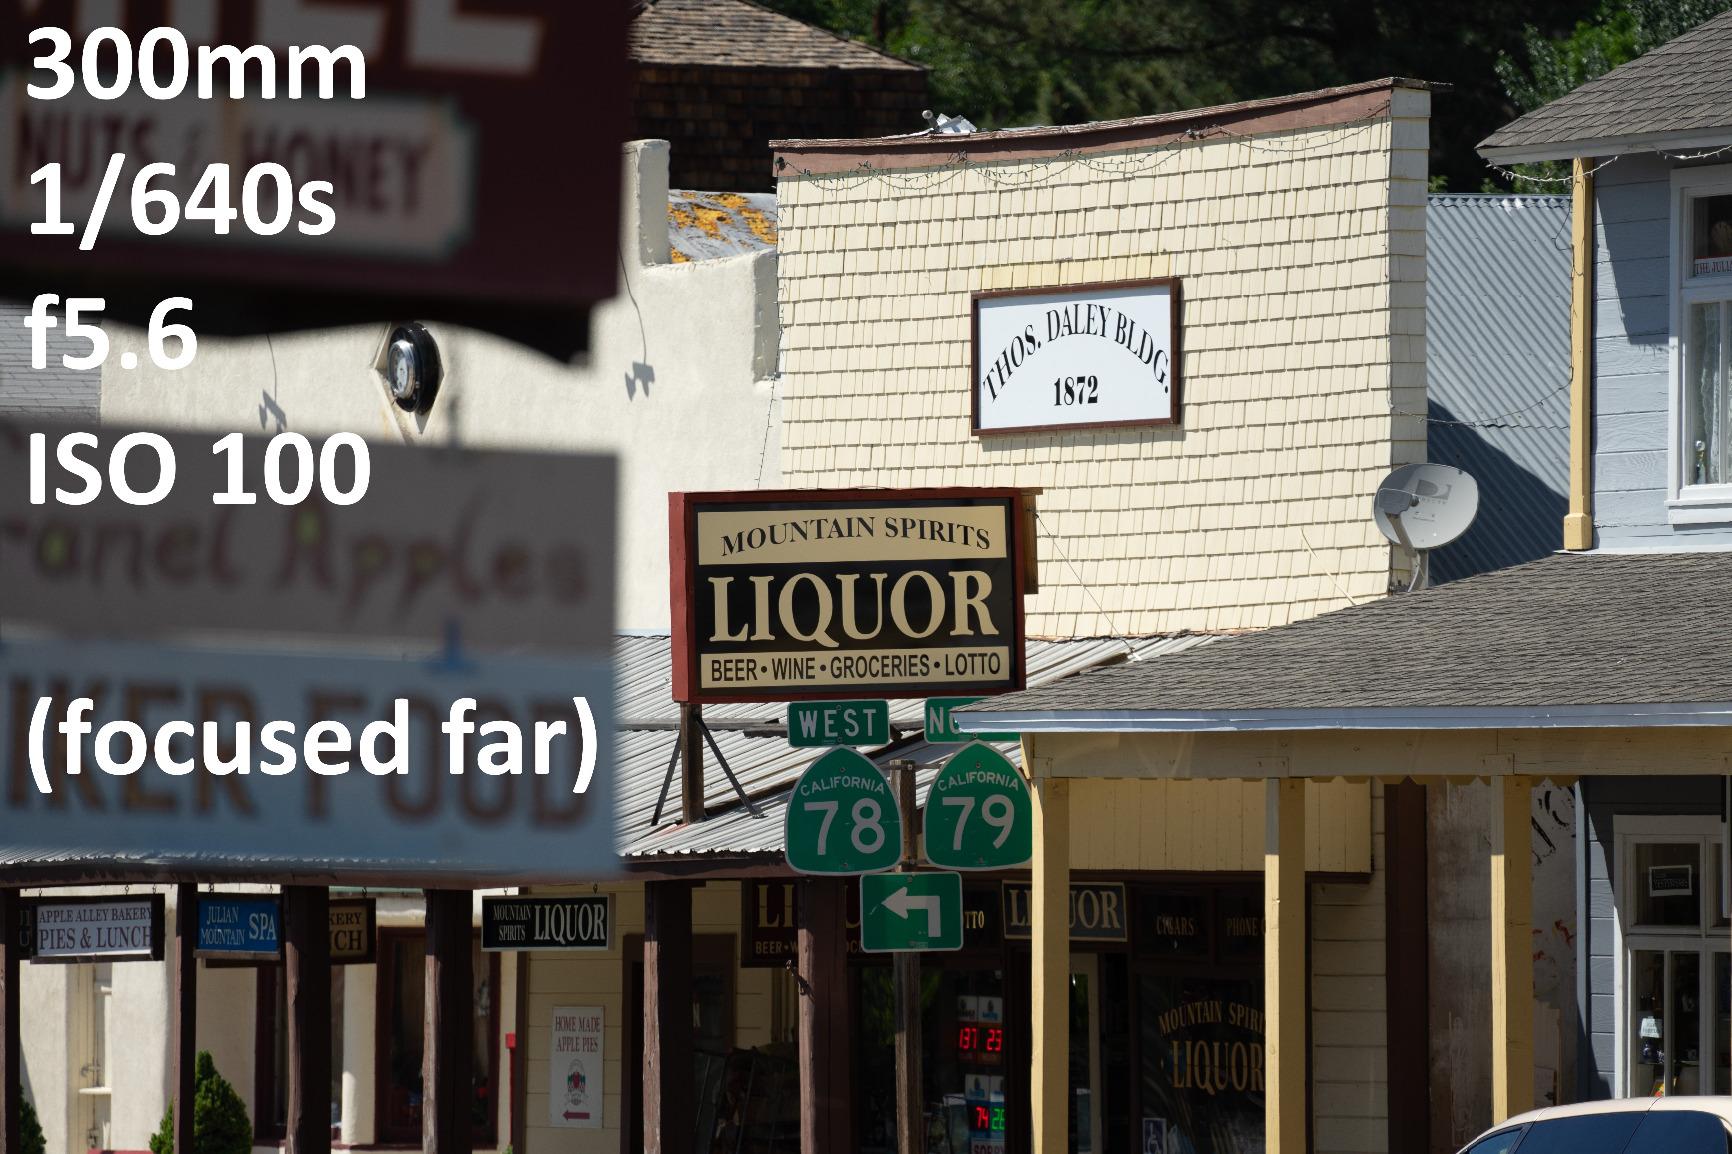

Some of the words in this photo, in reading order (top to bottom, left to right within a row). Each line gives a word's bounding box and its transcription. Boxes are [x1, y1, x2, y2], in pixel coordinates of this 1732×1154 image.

[982, 324, 1041, 402] THOS.
[1046, 303, 1111, 342] DALEY
[1115, 311, 1169, 394] BLDG.
[1053, 375, 1098, 406] 1872
[720, 516, 875, 557] MOUNTAIN
[885, 516, 990, 550] SPIRITS
[708, 570, 999, 648] LIQUOR
[711, 658, 757, 682] BEER
[772, 656, 816, 680] WINE
[830, 653, 930, 679] GROCERIES
[945, 651, 1000, 676] LOTTO
[799, 709, 876, 737] WEST
[801, 775, 885, 796] CALIFORNIA
[938, 771, 1019, 791] CALIFORNIA
[804, 798, 885, 855] 78
[942, 794, 1014, 850] 79
[40, 910, 73, 923] APPLE
[77, 909, 109, 922] ALLEY
[112, 907, 151, 921] BAKERY
[206, 906, 239, 925] JULIAN
[249, 912, 277, 940] SPA
[493, 904, 531, 920] MOUNTAIN
[534, 903, 606, 945] LIQUOR
[964, 911, 985, 929] TTO
[40, 928, 76, 950] PIES
[80, 927, 91, 949] &
[95, 925, 151, 948] LUNCH
[200, 927, 245, 945] MOUNTAIN
[499, 924, 526, 941] SPIRITS
[555, 1016, 576, 1032] HOME
[579, 1016, 600, 1032] MADE
[1159, 999, 1222, 1037] MOUNTAIN
[1228, 1000, 1264, 1034] SPIRI
[556, 1036, 580, 1052] APPLE
[583, 1036, 599, 1052] PIES
[1170, 1040, 1265, 1096] LIQUOR
